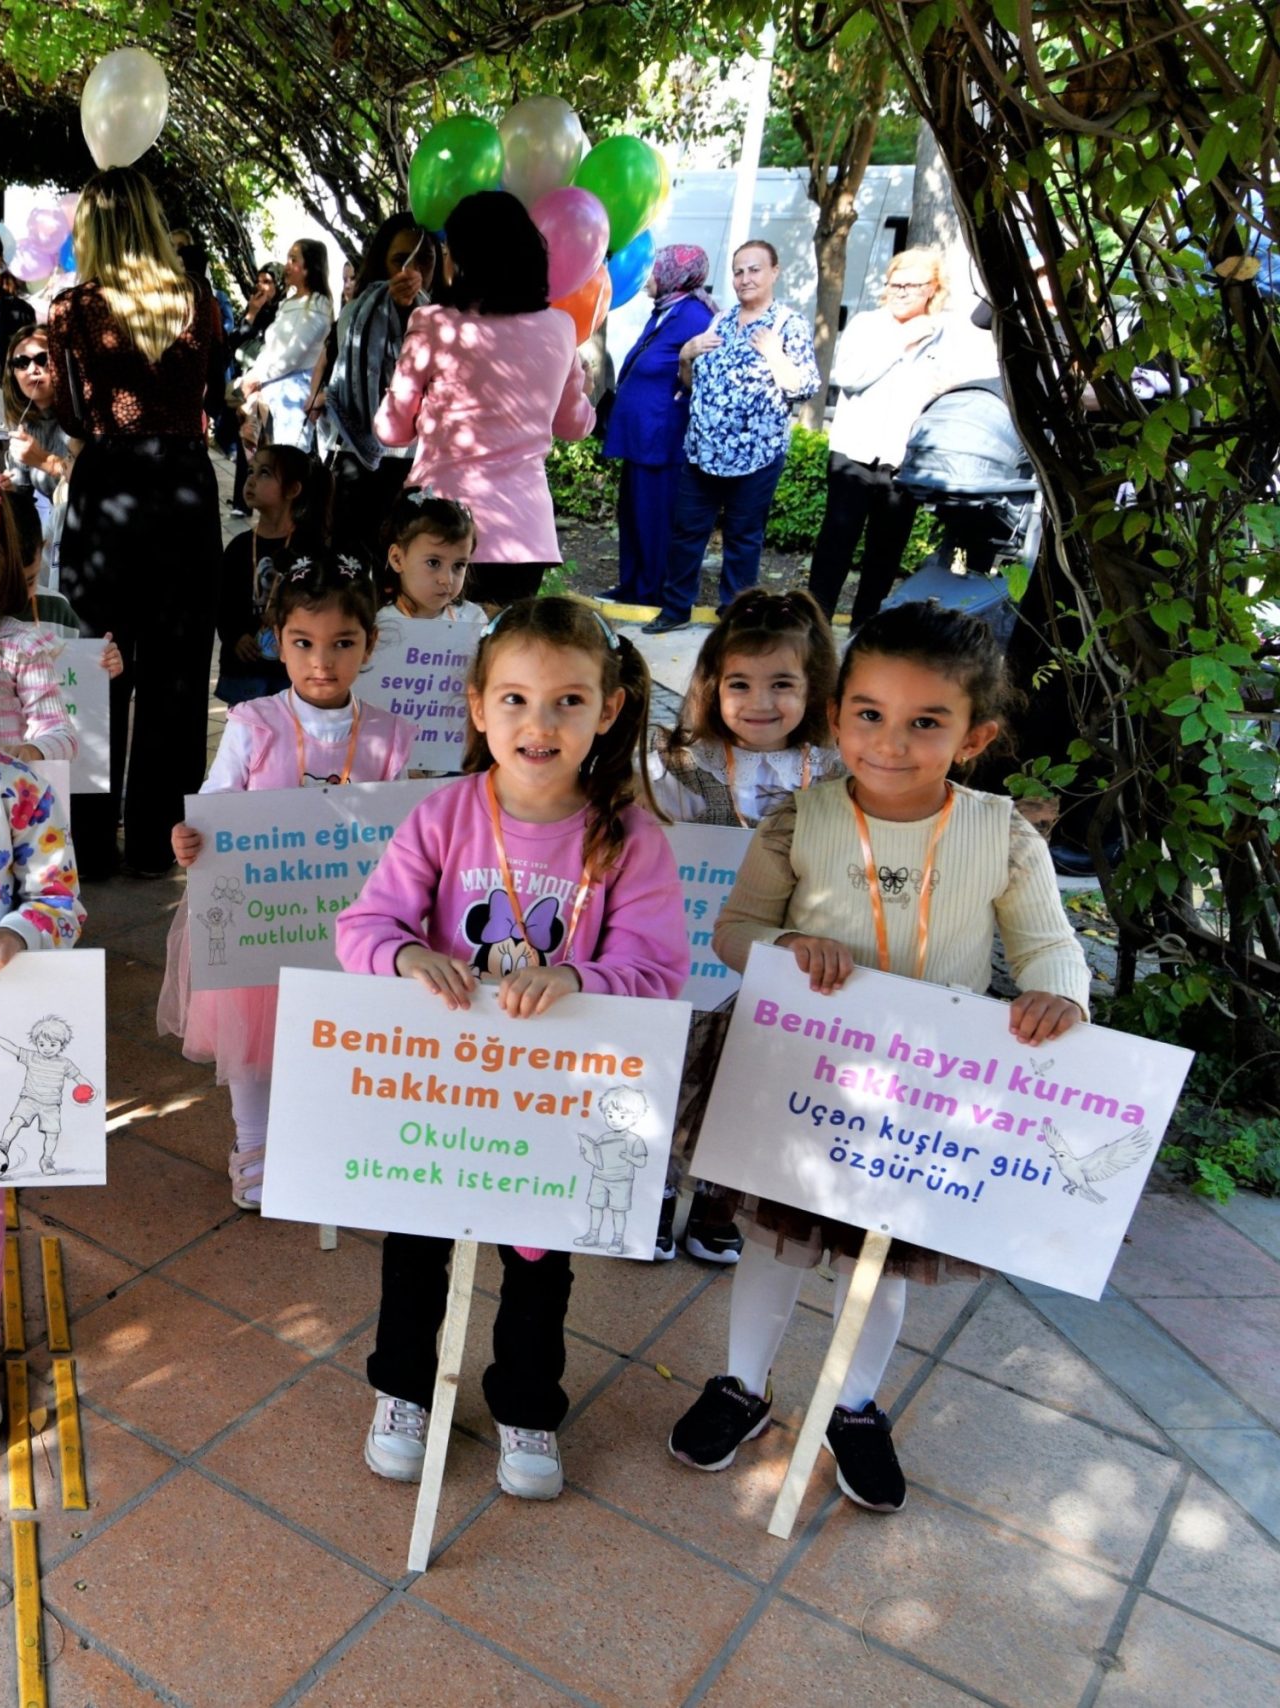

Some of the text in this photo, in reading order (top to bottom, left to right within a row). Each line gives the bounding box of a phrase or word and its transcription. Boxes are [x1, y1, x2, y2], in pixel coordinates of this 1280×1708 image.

[406, 647, 468, 667] Benim
[380, 674, 463, 695] sevgi do
[391, 698, 466, 720] büyüme
[215, 821, 394, 853] Benim eğlen
[245, 859, 348, 884] hakkım
[247, 899, 308, 922] Oyun,
[239, 924, 328, 946] mutluluk
[312, 1020, 644, 1077] Benim öğrenme
[753, 999, 1146, 1126] Benim hayal kurma
[351, 1067, 593, 1118] hakkım var!
[814, 1055, 1053, 1142] hakkım var!
[399, 1121, 529, 1156] Okuluma
[788, 1091, 1052, 1187] Uçan kuşlar gibi
[344, 1158, 577, 1199] gitmek isterim!
[829, 1136, 985, 1203] özgürüm!
